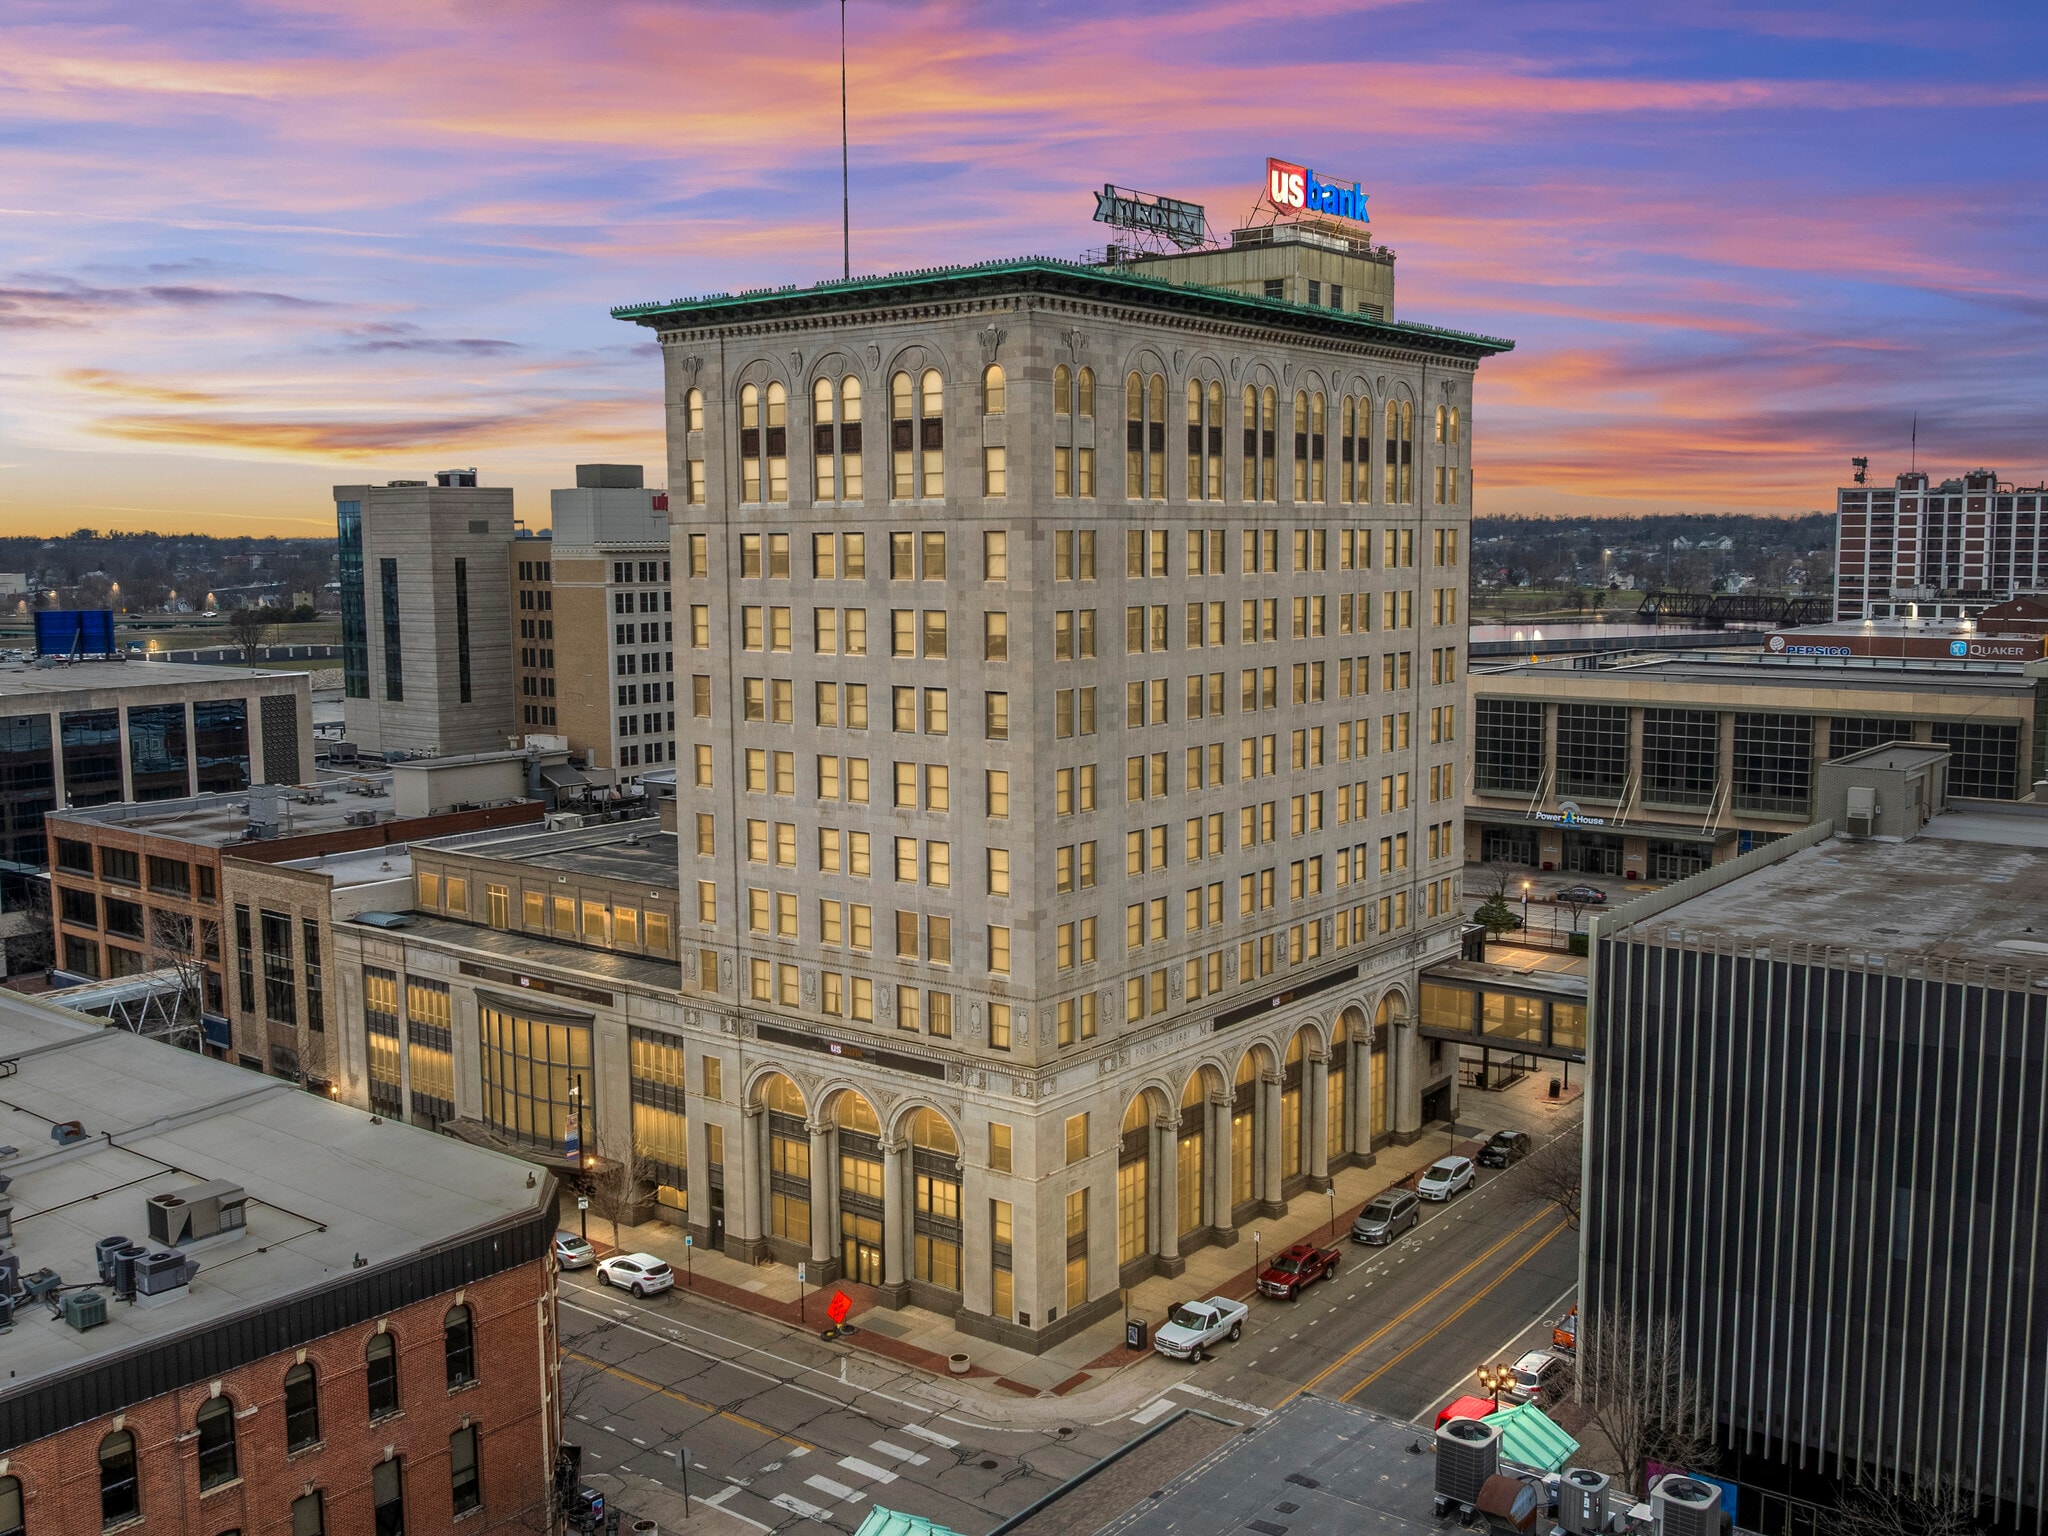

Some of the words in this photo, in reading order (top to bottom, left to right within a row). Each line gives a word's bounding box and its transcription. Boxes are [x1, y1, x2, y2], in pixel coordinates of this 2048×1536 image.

[652, 492, 668, 512] uf
[1786, 645, 1851, 656] PEPSICO
[1970, 644, 2024, 657] QUAKER
[1535, 811, 1562, 822] Power
[1576, 815, 1604, 825] House
[1136, 1036, 1173, 1057] FOUNDED
